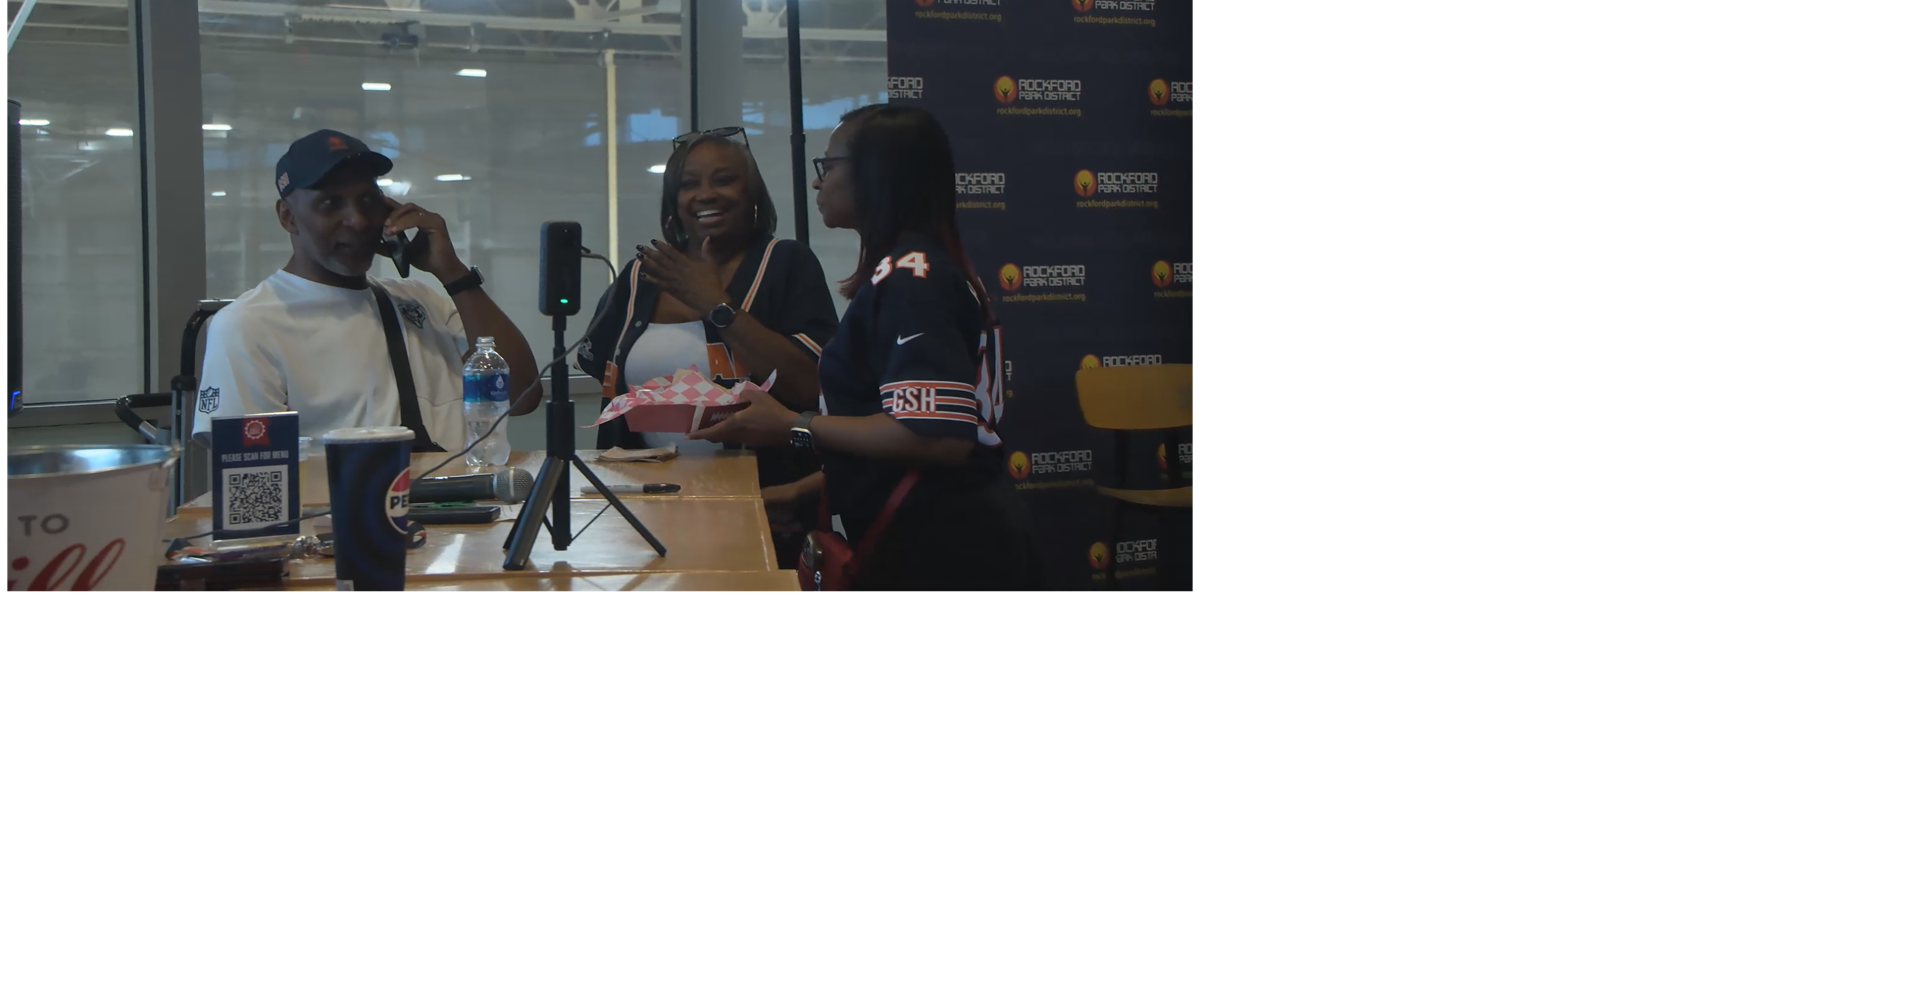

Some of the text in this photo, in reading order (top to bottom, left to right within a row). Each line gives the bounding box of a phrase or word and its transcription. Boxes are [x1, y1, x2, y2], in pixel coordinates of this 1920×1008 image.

[1119, 1, 1155, 11] DISTRICT
[915, 10, 1002, 22] rockfordparkdistrict.org
[1073, 15, 1155, 27] rockfordparkdistrict.org
[1018, 79, 1081, 92] ROCKFORD
[1044, 91, 1081, 101] DISTRICT
[996, 106, 1082, 117] rockfordparkdistrict.org
[1097, 172, 1158, 184] ROCKFORD
[967, 185, 1006, 194] DISTRICT
[1122, 184, 1158, 193] DISTRICT
[1076, 199, 1158, 209] rockfordparkdistrict.org
[1023, 265, 1085, 278] ROCKFORD
[1048, 277, 1085, 287] DISTRICT
[1102, 354, 1162, 368] ROCKFORD
[200, 397, 218, 411] NFL
[892, 387, 936, 412] GSH
[221, 450, 289, 463] PLEASE SCAN FOR MENU
[1031, 450, 1092, 465] ROCKFORD
[1056, 461, 1092, 472] DISTRICT
[18, 514, 69, 537] TO
